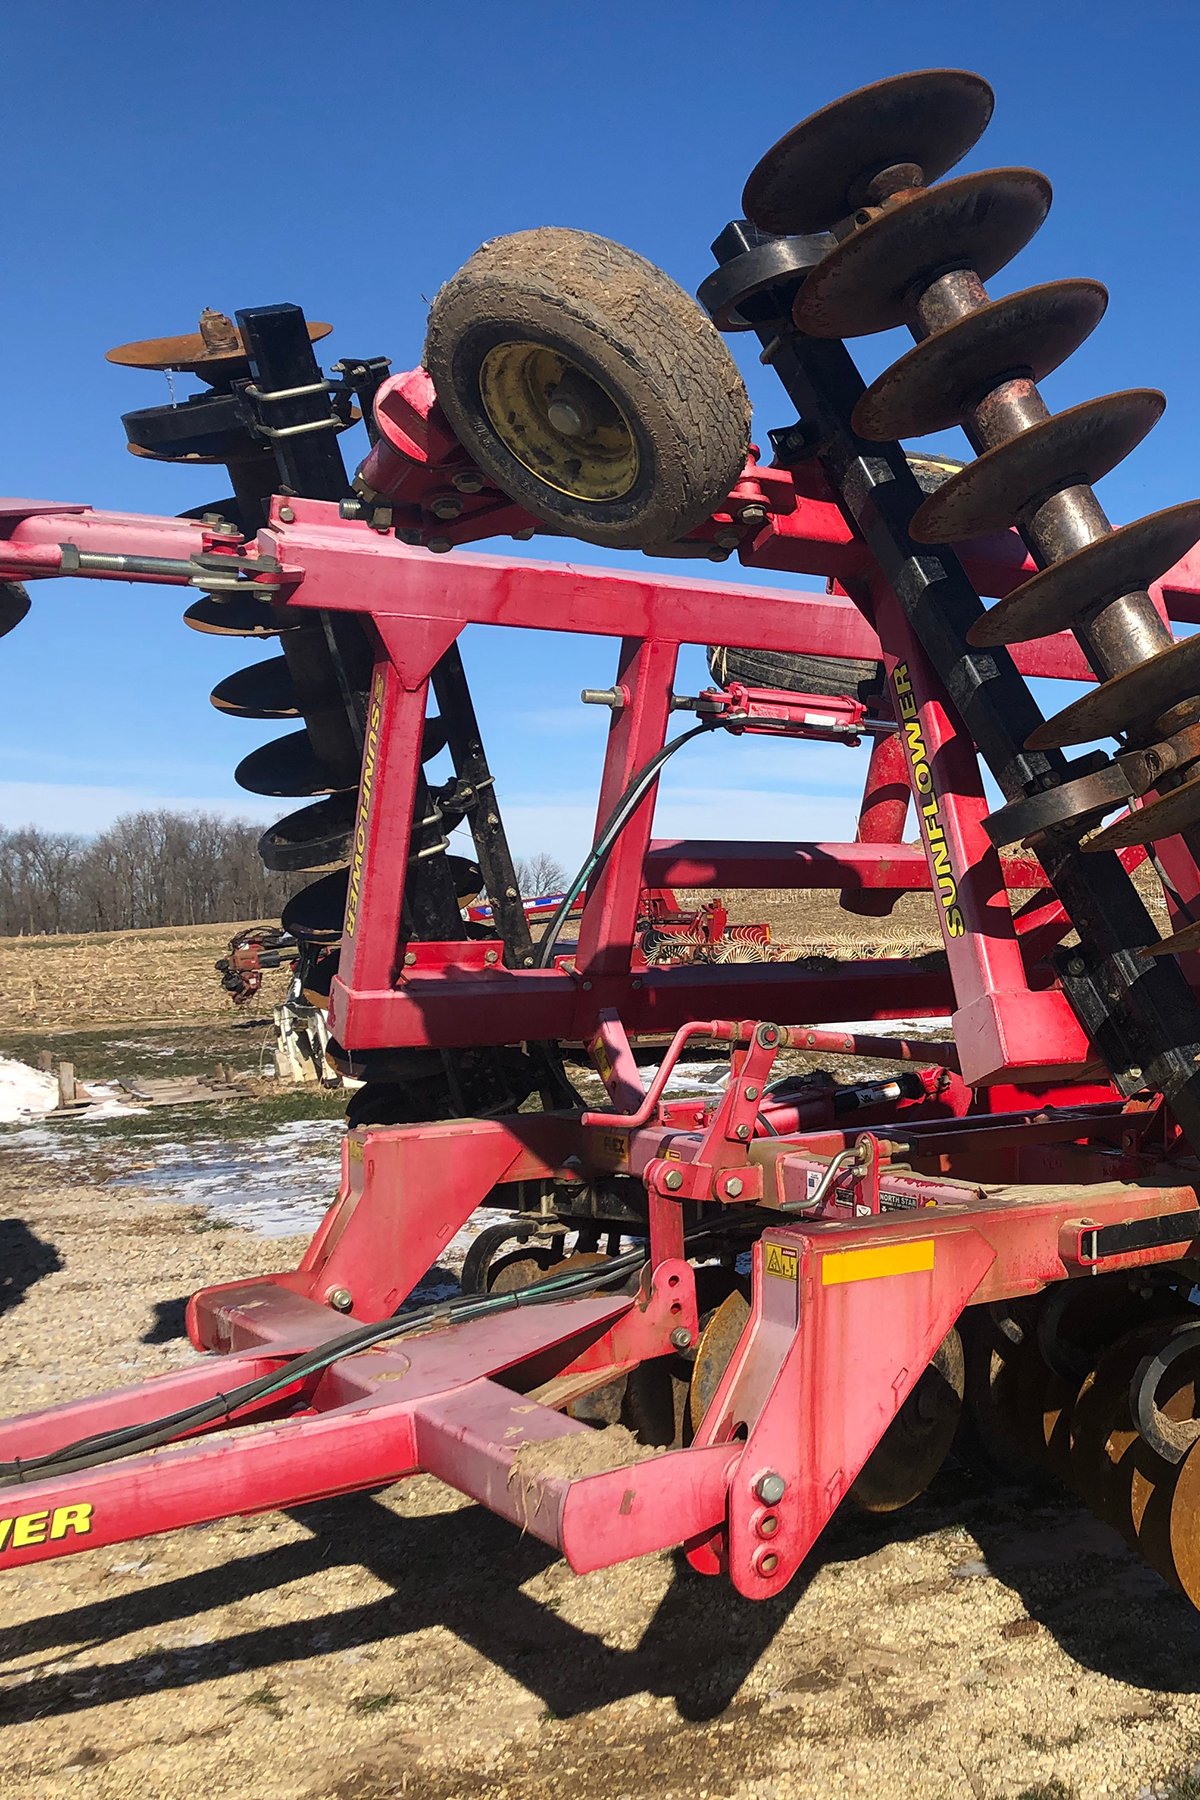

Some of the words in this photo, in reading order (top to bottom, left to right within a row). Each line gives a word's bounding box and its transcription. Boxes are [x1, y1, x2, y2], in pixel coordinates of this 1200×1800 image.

[345, 702, 380, 936] SUNFLOWER
[893, 663, 965, 938] SUNFLOWER
[880, 1194, 900, 1204] NORTH
